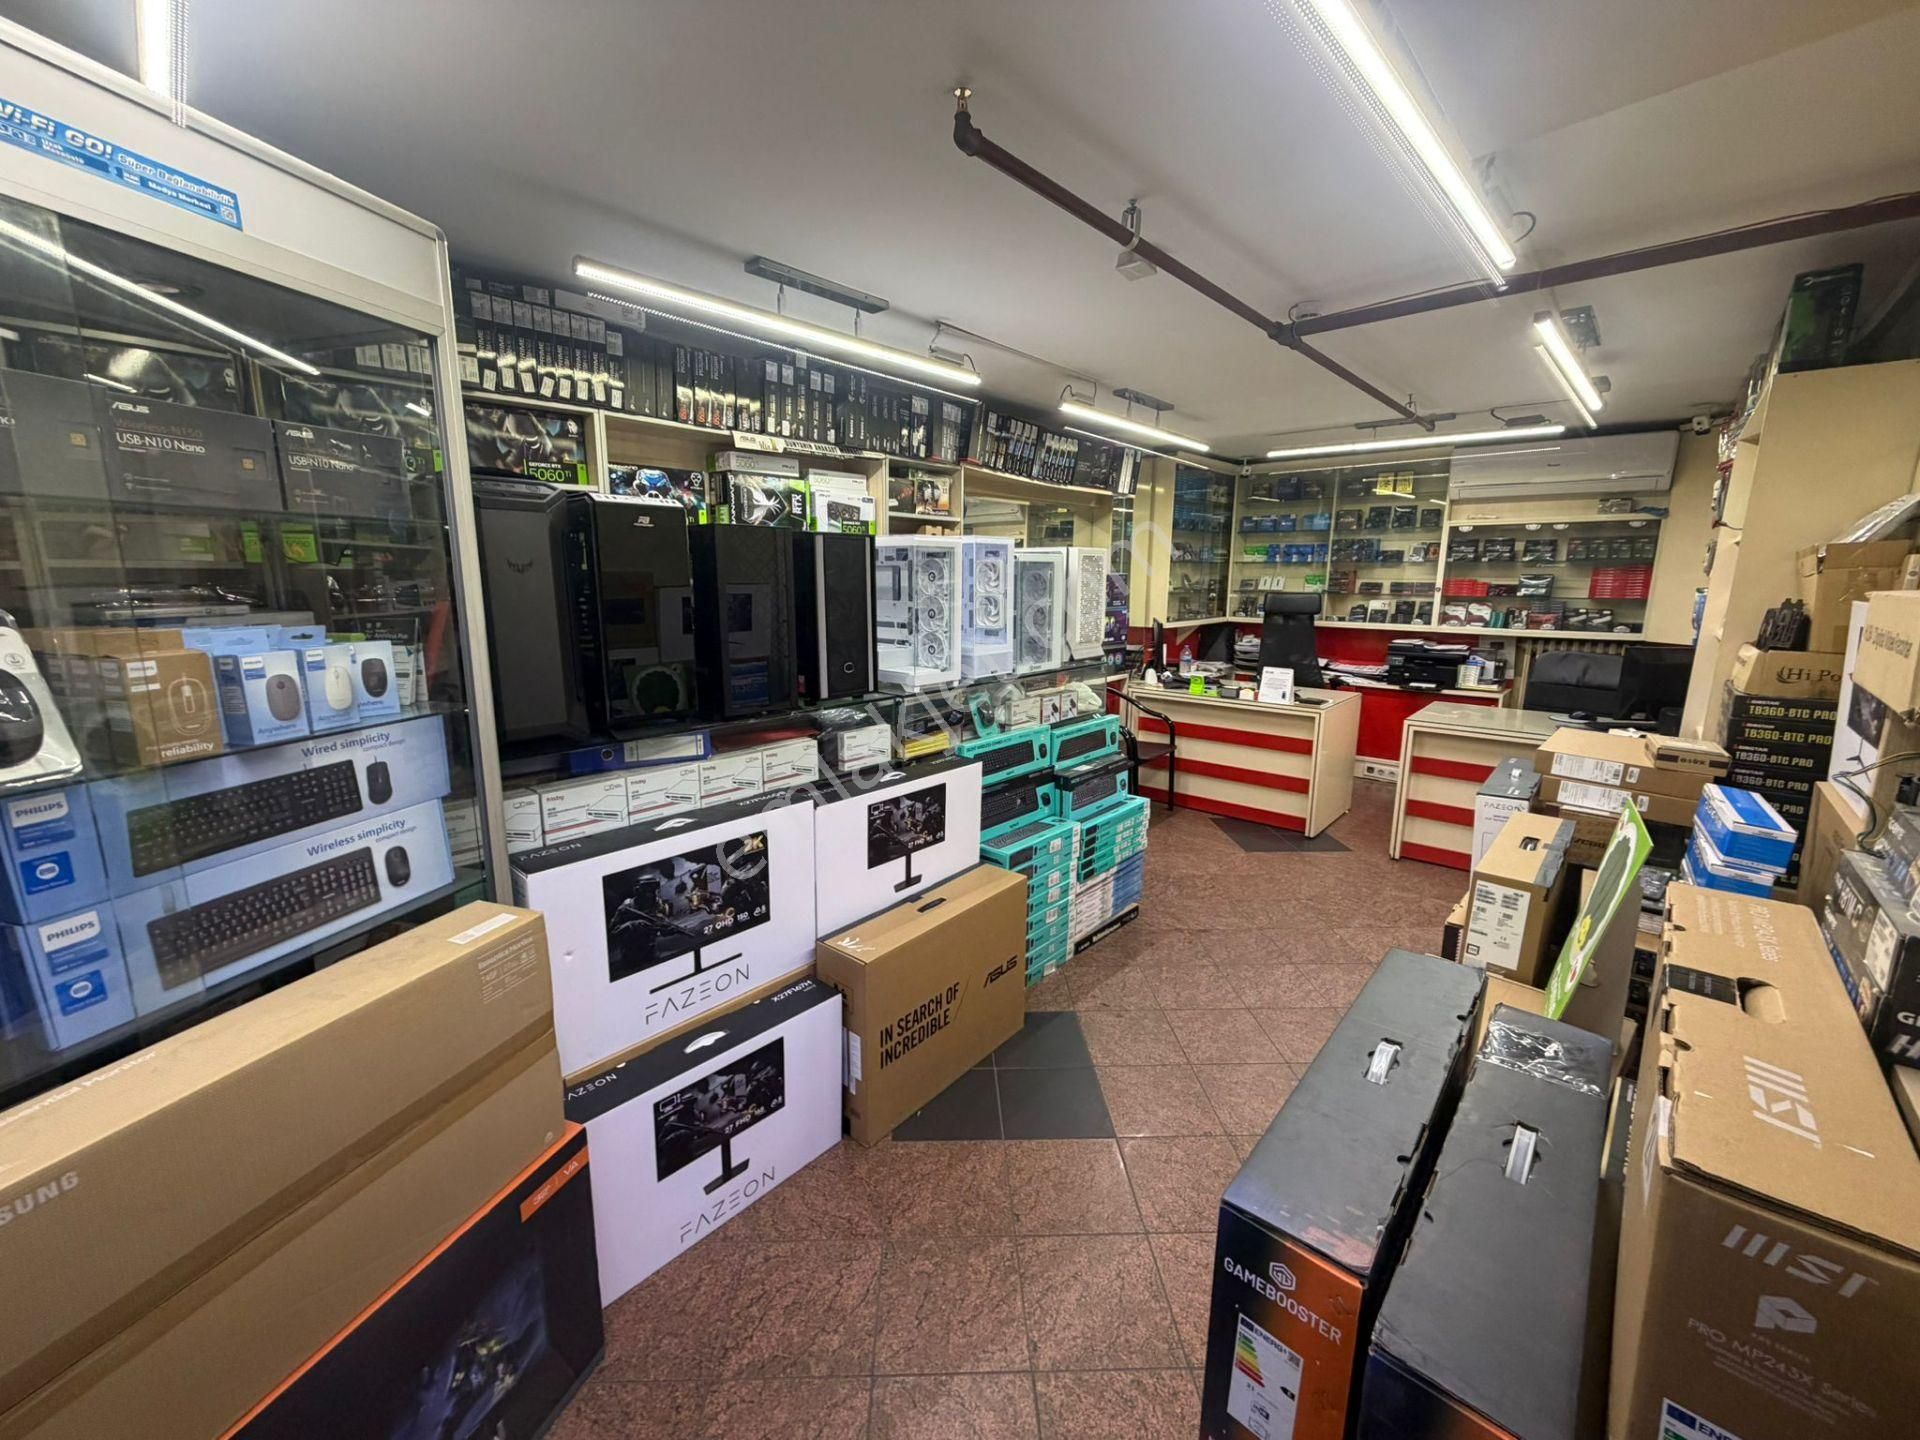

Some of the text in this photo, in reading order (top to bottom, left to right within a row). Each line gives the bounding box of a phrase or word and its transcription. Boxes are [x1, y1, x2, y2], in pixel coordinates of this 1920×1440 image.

[65, 129, 112, 159] GO!
[112, 401, 150, 414] ASUS
[116, 432, 206, 453] USB-N10 Nano
[529, 468, 565, 482] 5060
[795, 493, 803, 514] RTX
[1749, 705, 1838, 721] TB360-BTC PRO
[301, 732, 391, 758] Wired simplicity
[1744, 727, 1833, 746] TB360-BTC PRO
[161, 742, 214, 758] reliability
[1735, 750, 1814, 768] TB360-BTC PRO
[1786, 779, 1810, 792] PRO
[16, 801, 64, 818] PHILIPS
[1781, 803, 1805, 815] PRO
[307, 819, 406, 856] Wireless simplicity
[743, 835, 764, 853] 2K
[46, 921, 96, 942] PHILIPS
[703, 924, 713, 934] 27
[983, 955, 1018, 988] ASUS
[645, 963, 751, 1026] FAZEON
[880, 982, 960, 1048] IN SEARCH OF
[880, 1008, 951, 1070] INCREDIBLE
[568, 1073, 617, 1101] AZEON
[735, 1114, 752, 1128] FHD
[563, 1160, 579, 1176] VA
[0, 1171, 80, 1227] SUNG
[680, 1166, 775, 1243] FAZEON
[1721, 1224, 1880, 1298] MSI
[1224, 1256, 1342, 1345] GAMEBOOSTER
[1688, 1317, 1726, 1344] PRO
[1732, 1340, 1815, 1386] MP243X
[1821, 1381, 1878, 1419] Series
